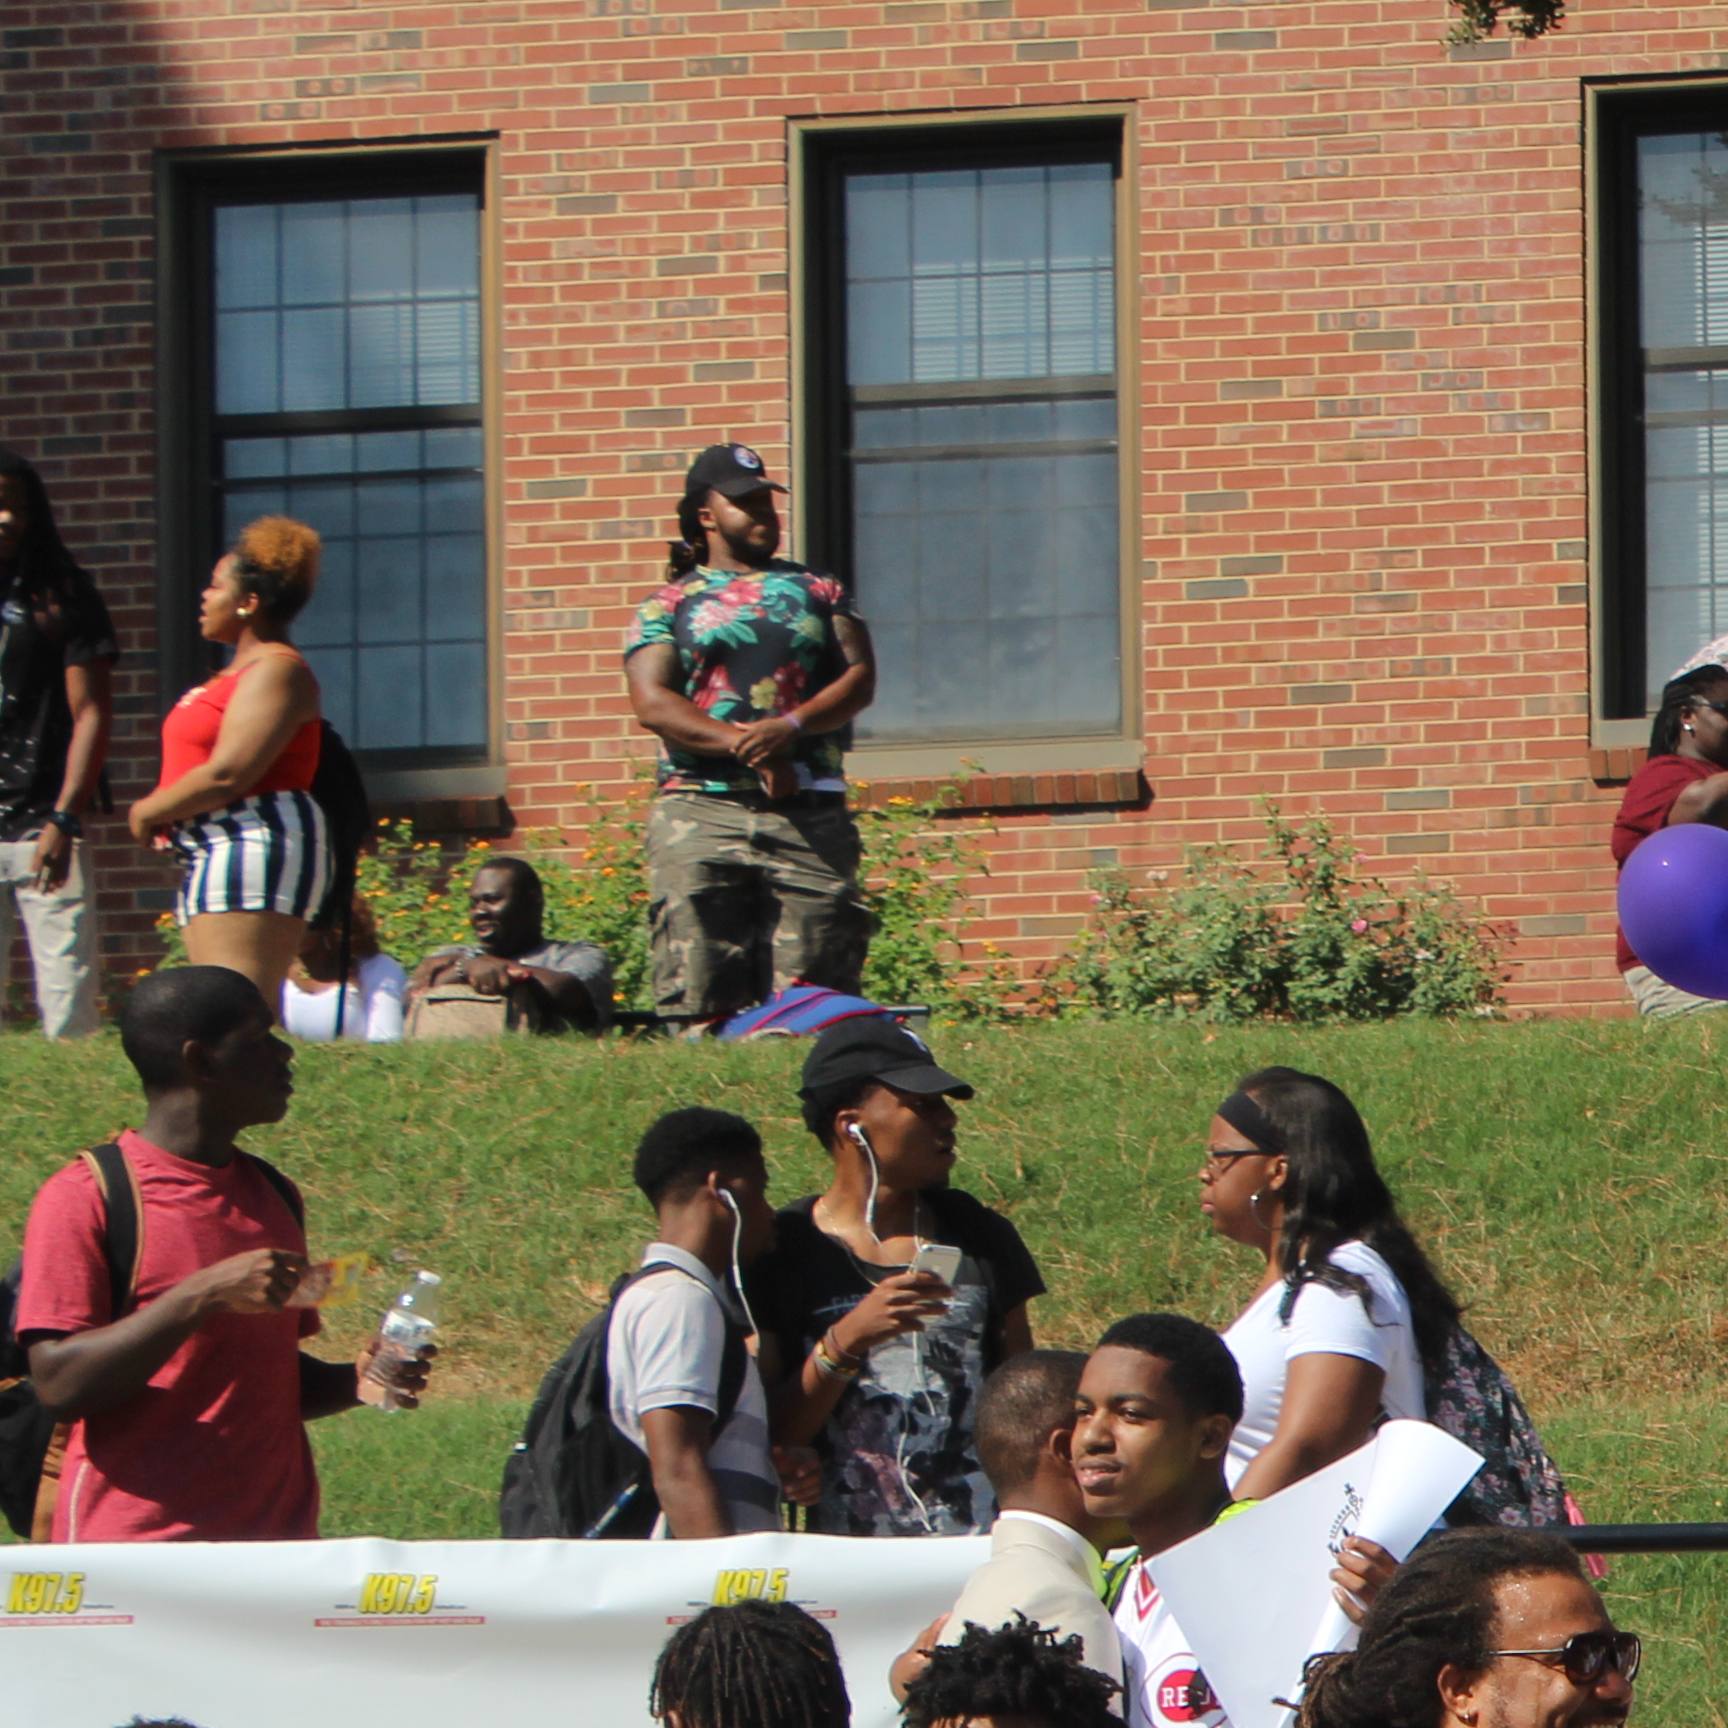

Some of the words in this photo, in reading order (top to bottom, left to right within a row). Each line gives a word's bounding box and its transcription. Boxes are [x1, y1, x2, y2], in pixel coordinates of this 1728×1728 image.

[6, 1572, 86, 1613] K97.5
[359, 1573, 438, 1614] K97.5
[712, 1567, 789, 1607] K975
